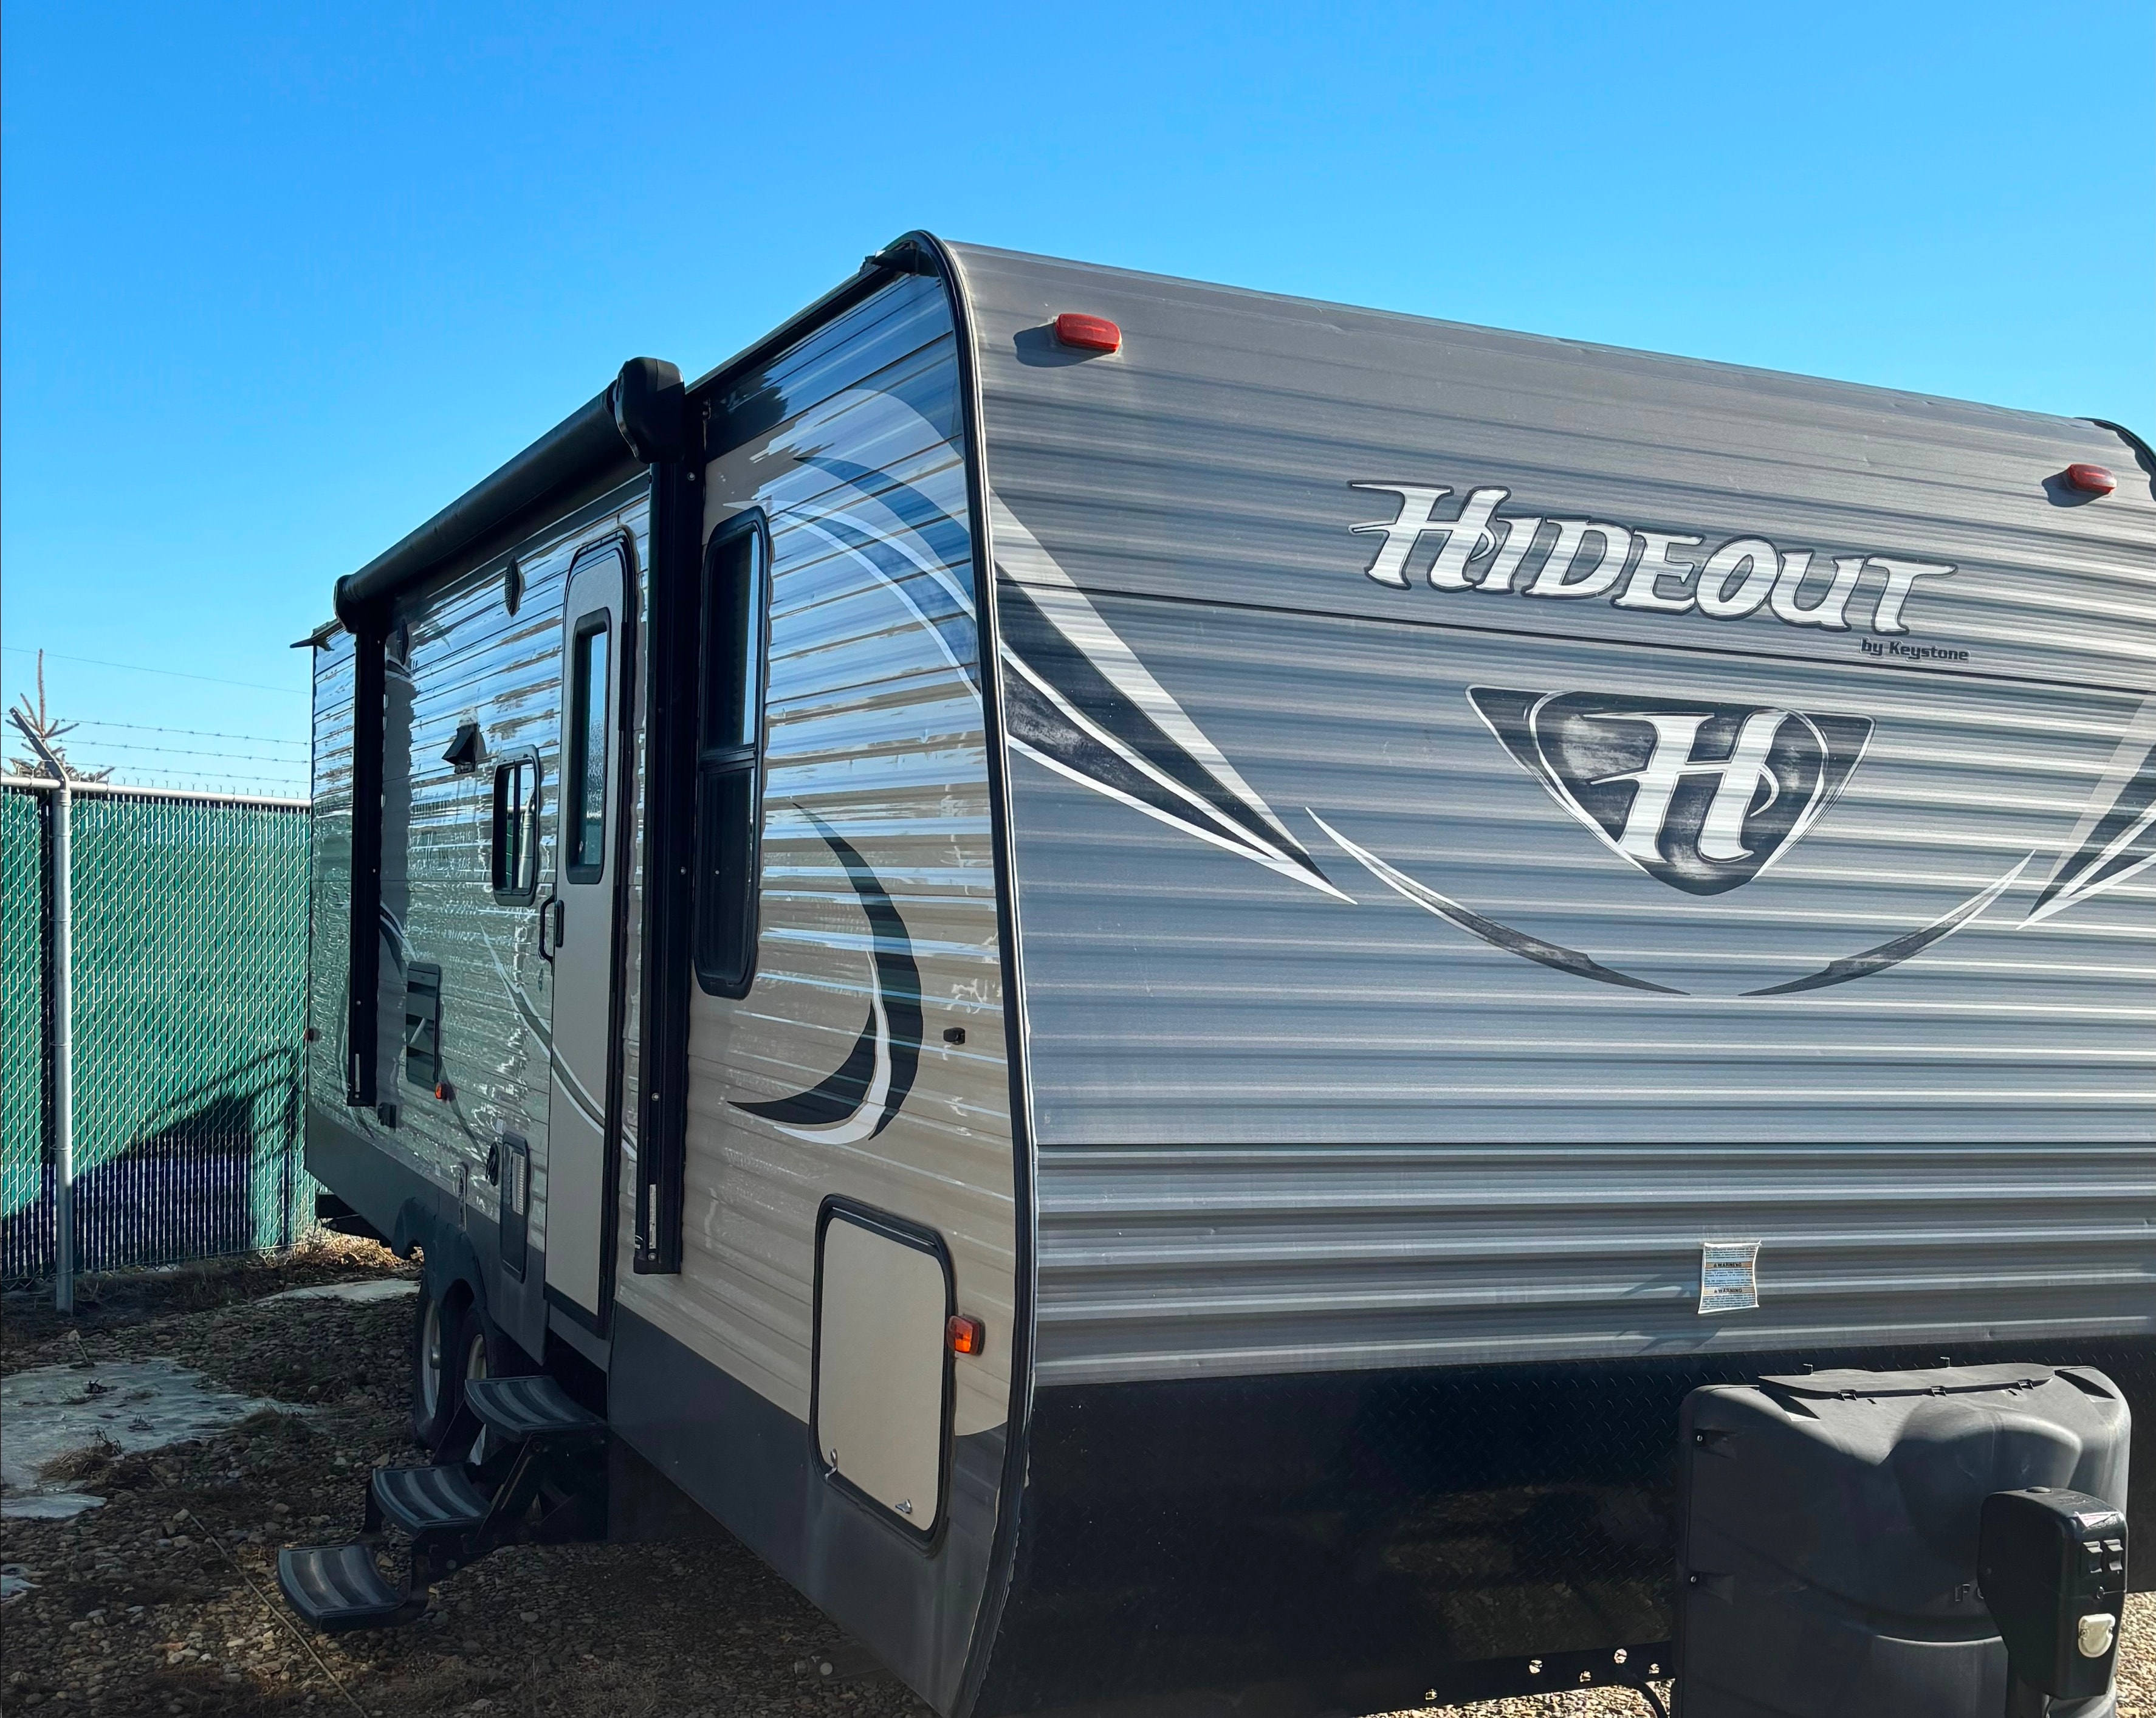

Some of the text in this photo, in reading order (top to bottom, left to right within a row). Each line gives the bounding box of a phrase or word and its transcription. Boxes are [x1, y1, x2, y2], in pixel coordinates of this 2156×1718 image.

[1348, 480, 1957, 635] HIDEOUT
[1861, 639, 1969, 661] by Keystone
[1583, 707, 1788, 864] H
